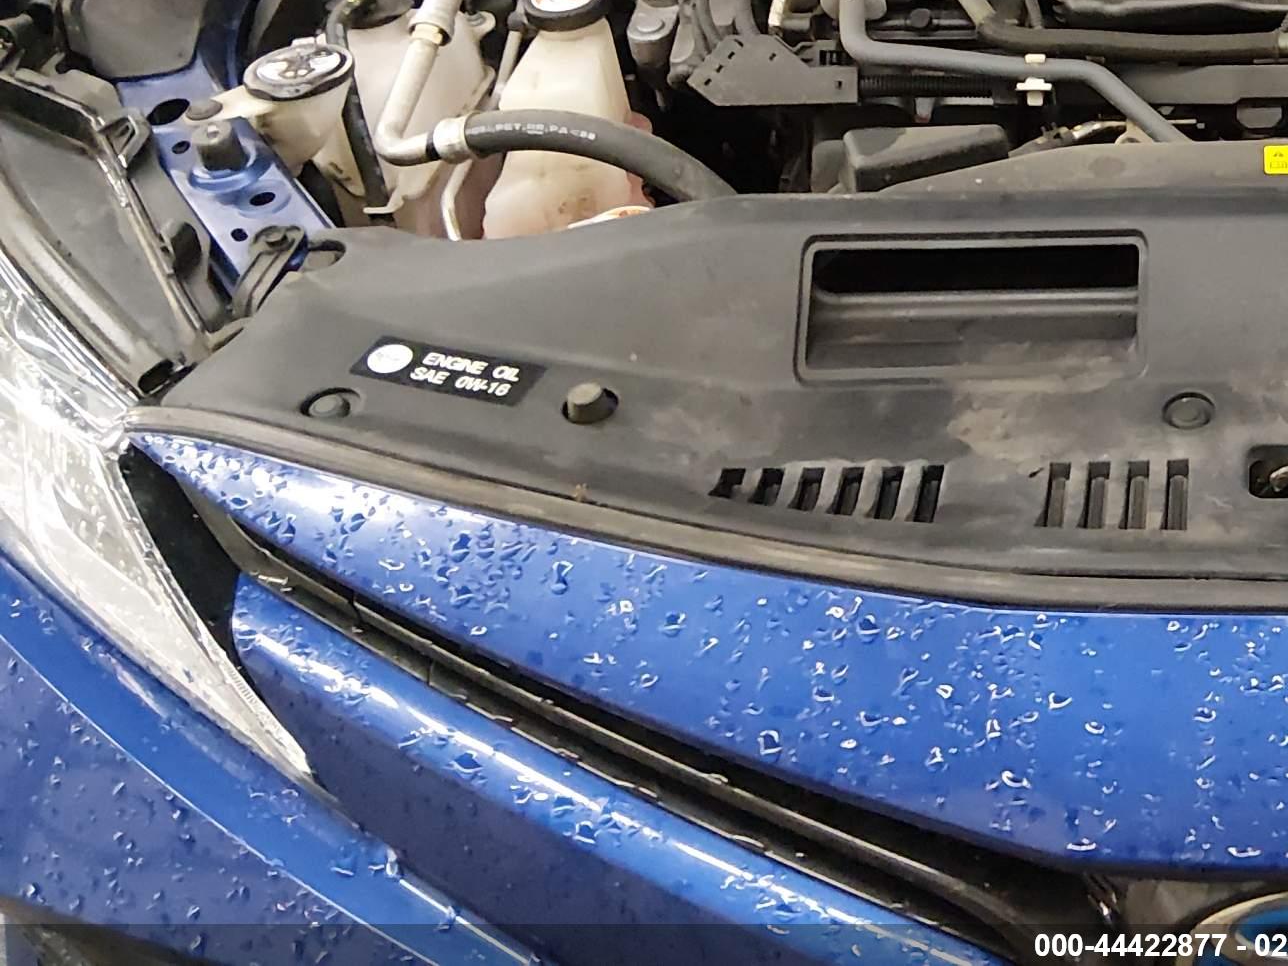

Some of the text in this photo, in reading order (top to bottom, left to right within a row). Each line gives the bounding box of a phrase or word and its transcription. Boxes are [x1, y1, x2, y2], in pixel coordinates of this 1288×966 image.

[410, 366, 513, 397] SAE 0W-16
[422, 352, 521, 382] ENGINE OIL
